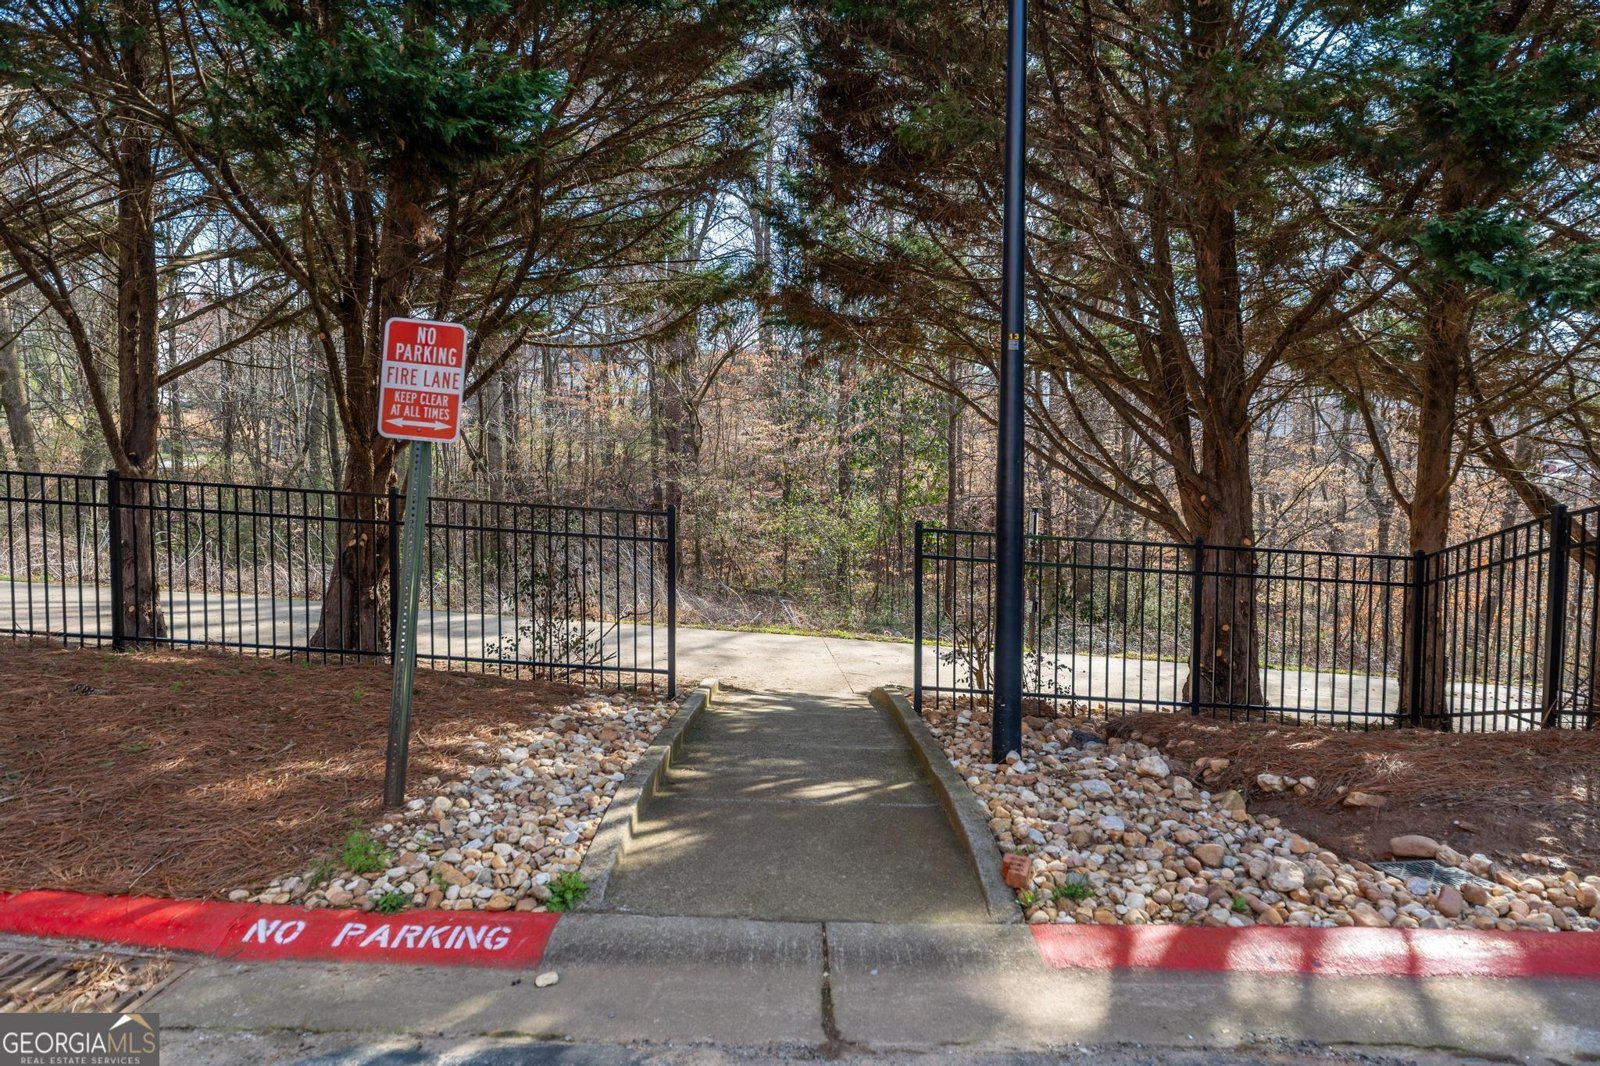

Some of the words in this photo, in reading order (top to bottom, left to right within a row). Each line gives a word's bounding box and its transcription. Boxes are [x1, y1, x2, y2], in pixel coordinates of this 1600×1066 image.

[417, 327, 436, 344] NO
[395, 343, 457, 365] PARKING
[387, 366, 418, 385] FIRE
[424, 370, 459, 390] LANE
[394, 391, 417, 403] KEEP
[420, 393, 448, 406] CLEAR
[391, 404, 401, 415] AT
[404, 406, 420, 417] ALL
[424, 408, 450, 420] TIMES
[241, 918, 306, 944] NO
[330, 923, 512, 950] PARKING
